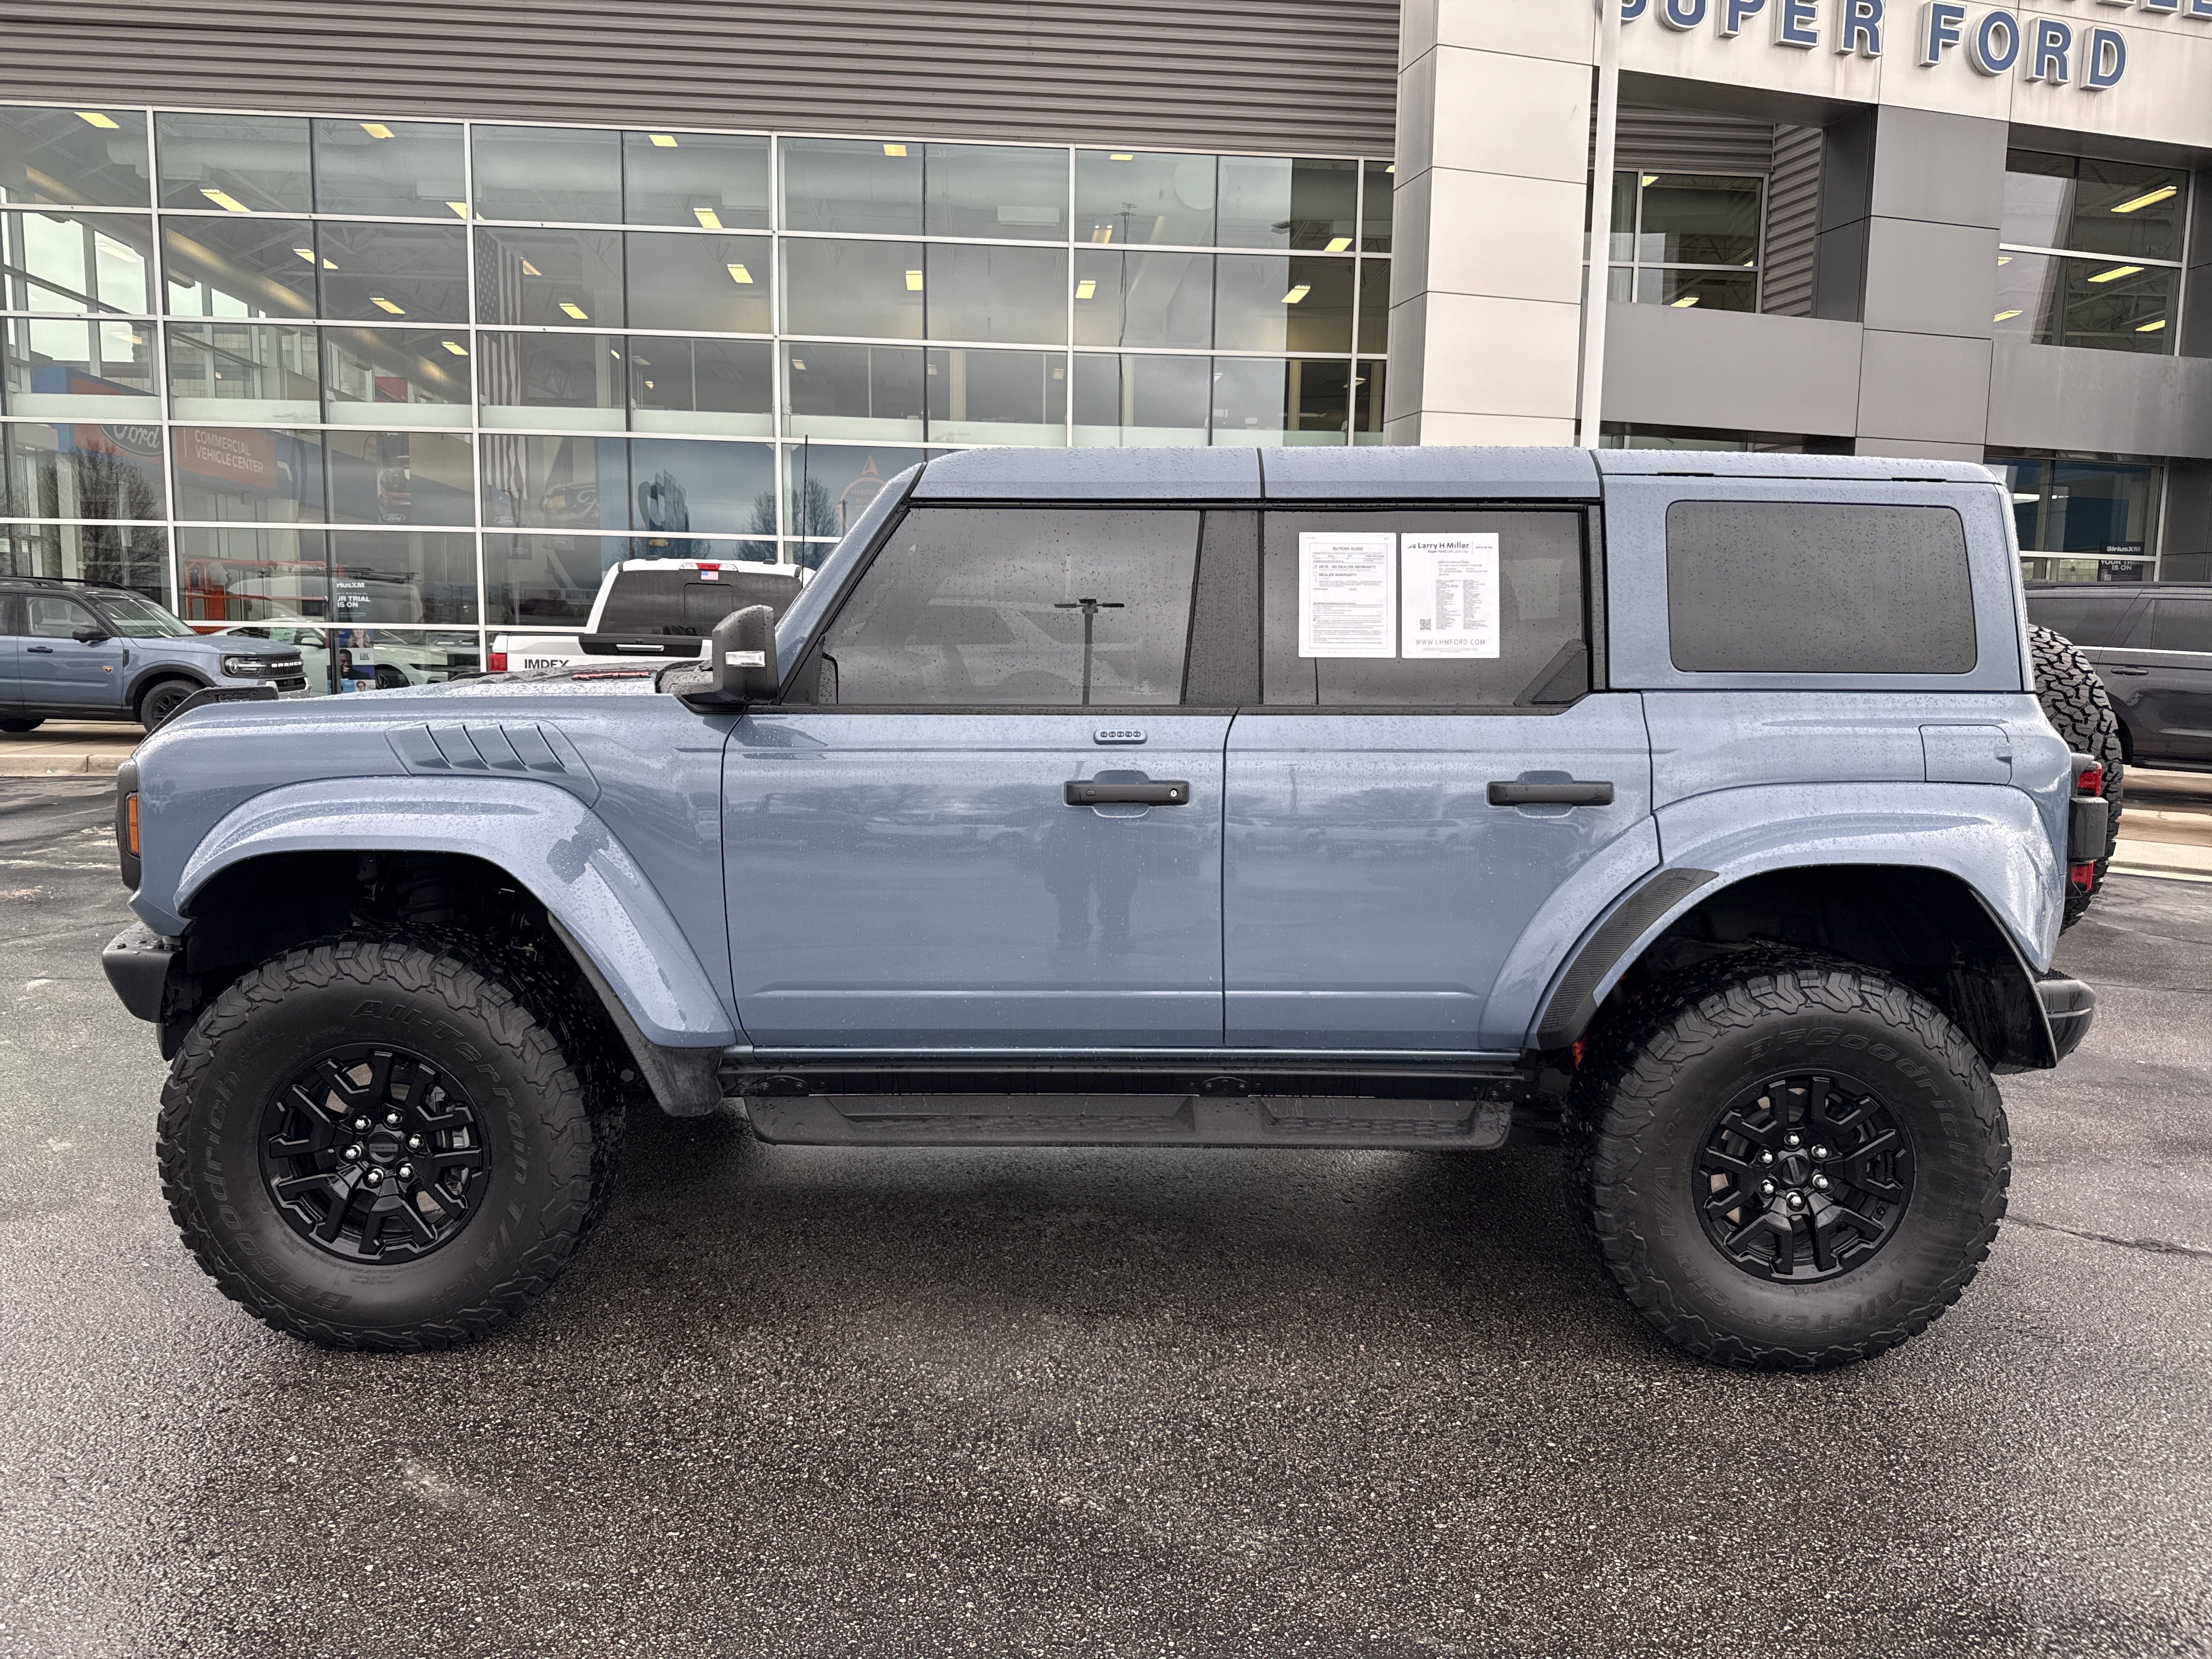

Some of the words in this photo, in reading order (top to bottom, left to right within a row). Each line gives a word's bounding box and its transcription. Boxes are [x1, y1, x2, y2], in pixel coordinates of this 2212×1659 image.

[1618, 0, 1884, 59] UPER
[1920, 1, 2128, 92] FORD
[195, 429, 251, 456] COMMERCIAL
[195, 444, 232, 466] VEHICLE
[232, 455, 263, 474] CENTER
[524, 658, 569, 669] IMDEX
[350, 1000, 529, 1185] All-Terrain
[475, 1200, 527, 1272] T/A
[1743, 1027, 1970, 1166] BFGoodrich
[202, 1071, 352, 1311] BFGoodrich
[1653, 1167, 1678, 1243] T/A
[1676, 1255, 1903, 1334] All-Terrain
